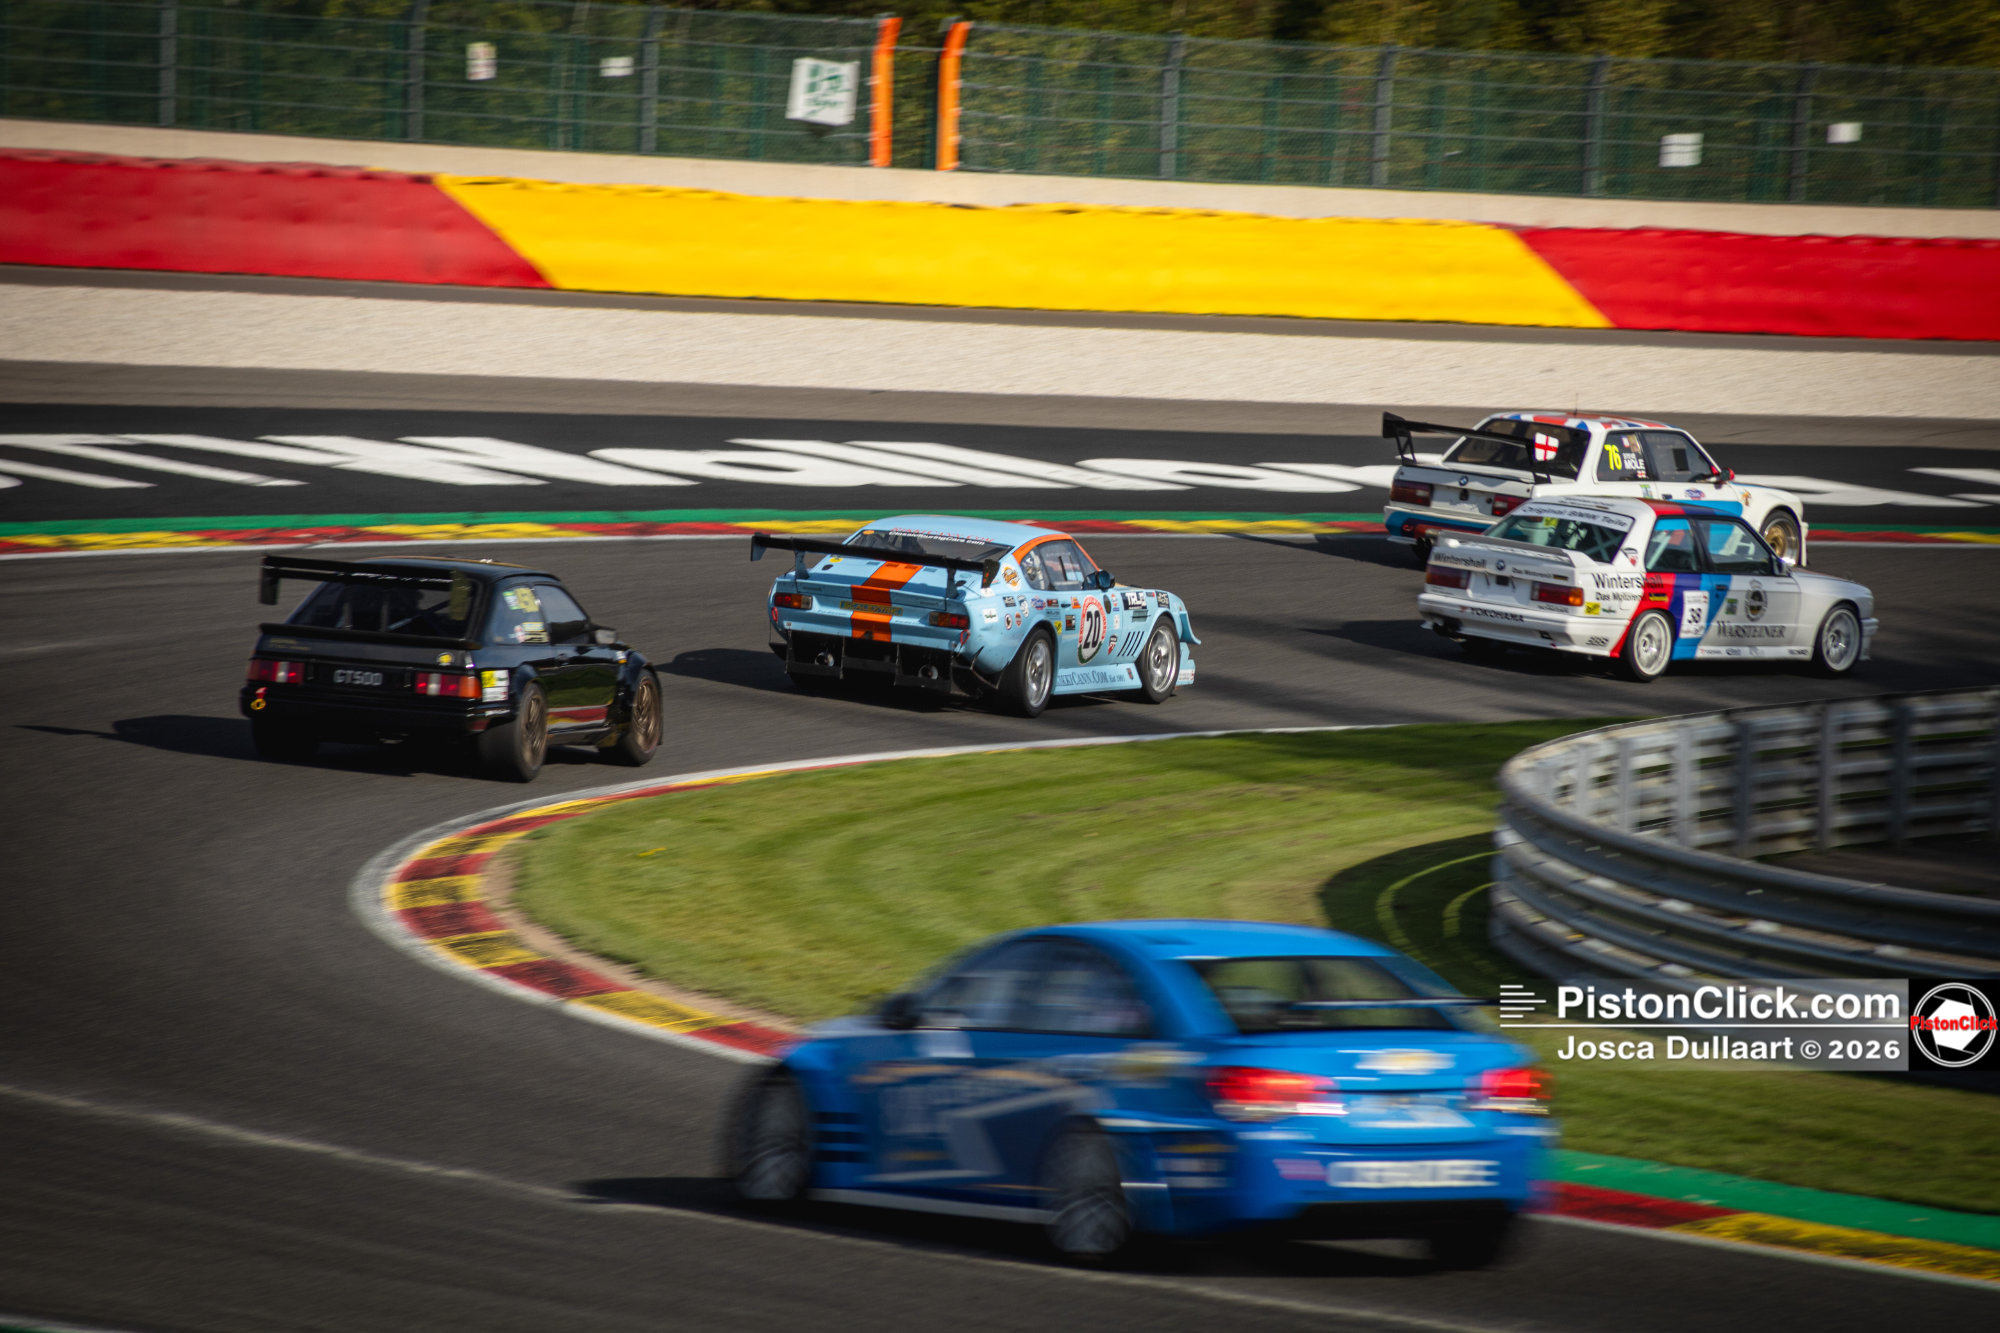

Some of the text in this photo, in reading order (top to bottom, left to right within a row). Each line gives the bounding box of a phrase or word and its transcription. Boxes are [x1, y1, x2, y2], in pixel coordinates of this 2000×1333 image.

[1604, 444, 1622, 470] 76
[1624, 459, 1646, 470] MOLE
[1433, 552, 1487, 568] Wintershall
[1592, 573, 1664, 589] Wintershall
[1595, 592, 1610, 600] Das
[1471, 607, 1524, 622] YOKOHAMA
[1083, 610, 1101, 650] 20
[1716, 620, 1786, 639] WARSTEINER
